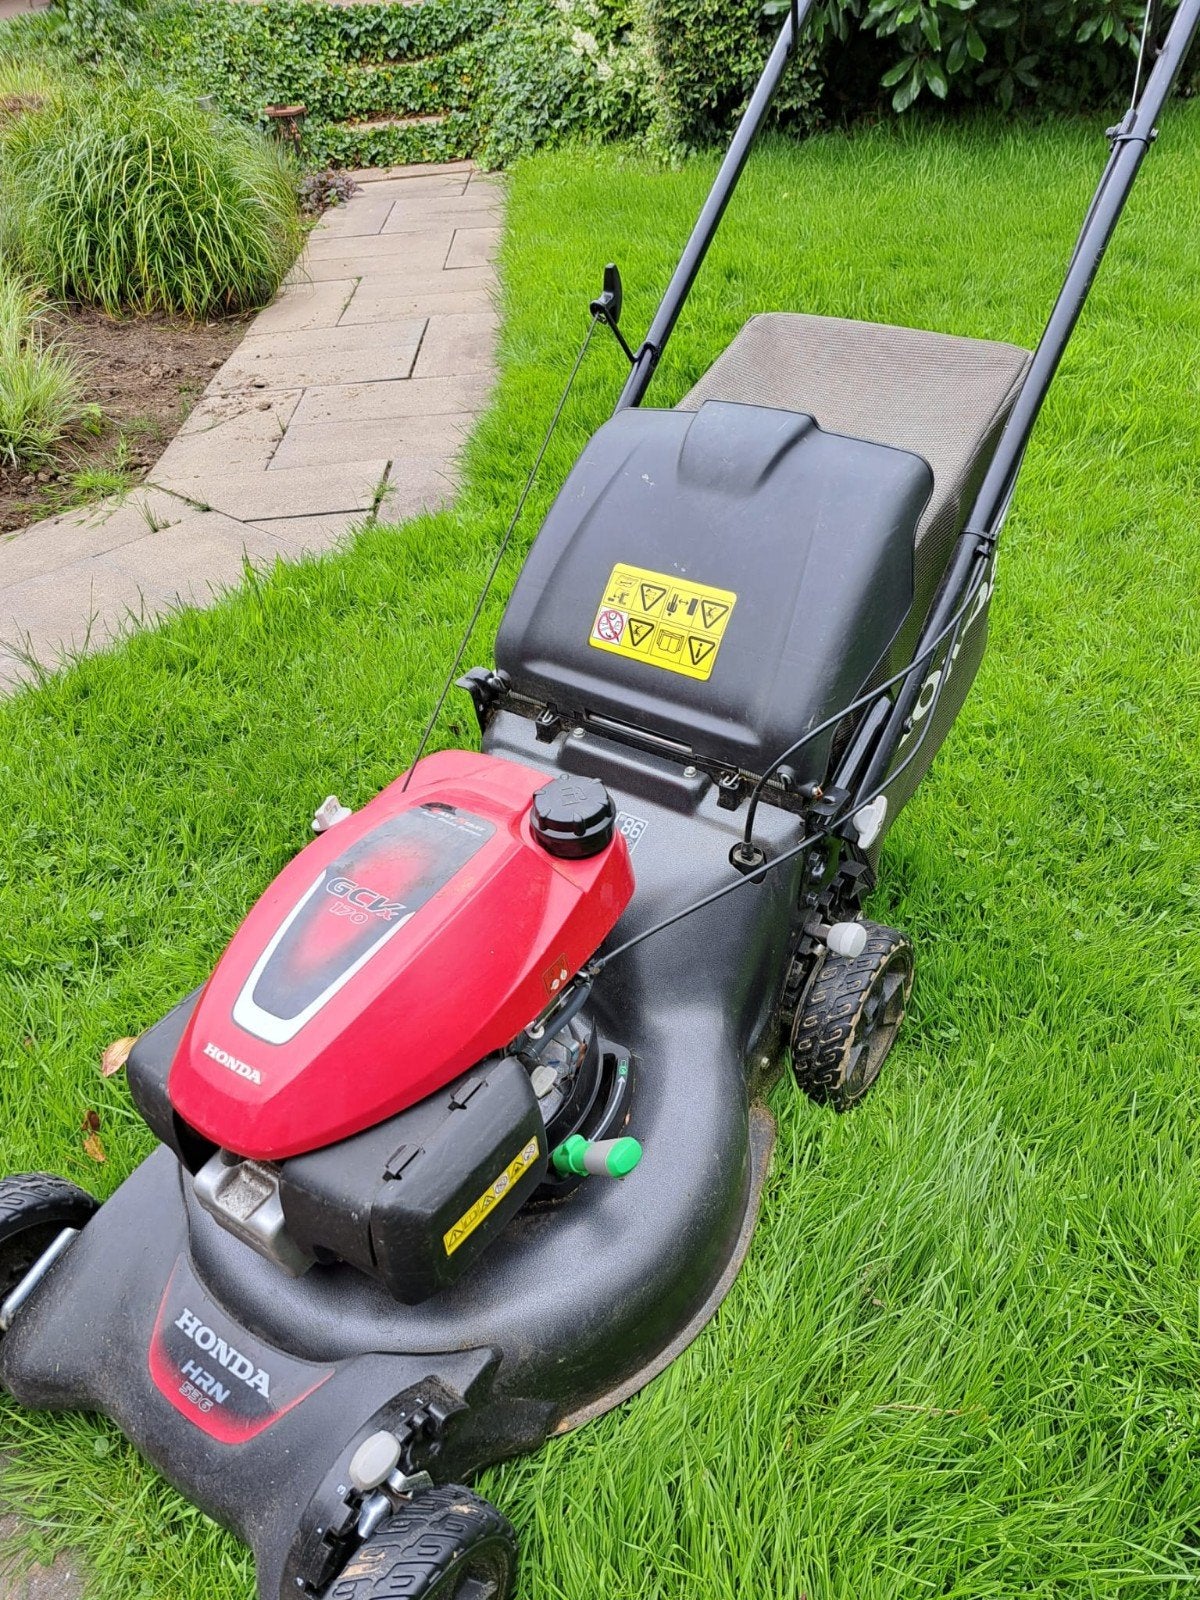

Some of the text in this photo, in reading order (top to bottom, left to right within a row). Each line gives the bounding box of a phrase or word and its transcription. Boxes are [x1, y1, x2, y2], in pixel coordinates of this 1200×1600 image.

[620, 817, 645, 839] 86
[329, 901, 368, 924] 170
[203, 1042, 261, 1085] HONDA
[174, 1308, 270, 1398] HONDA
[179, 1381, 214, 1413] 536
[181, 1359, 231, 1404] HRN
